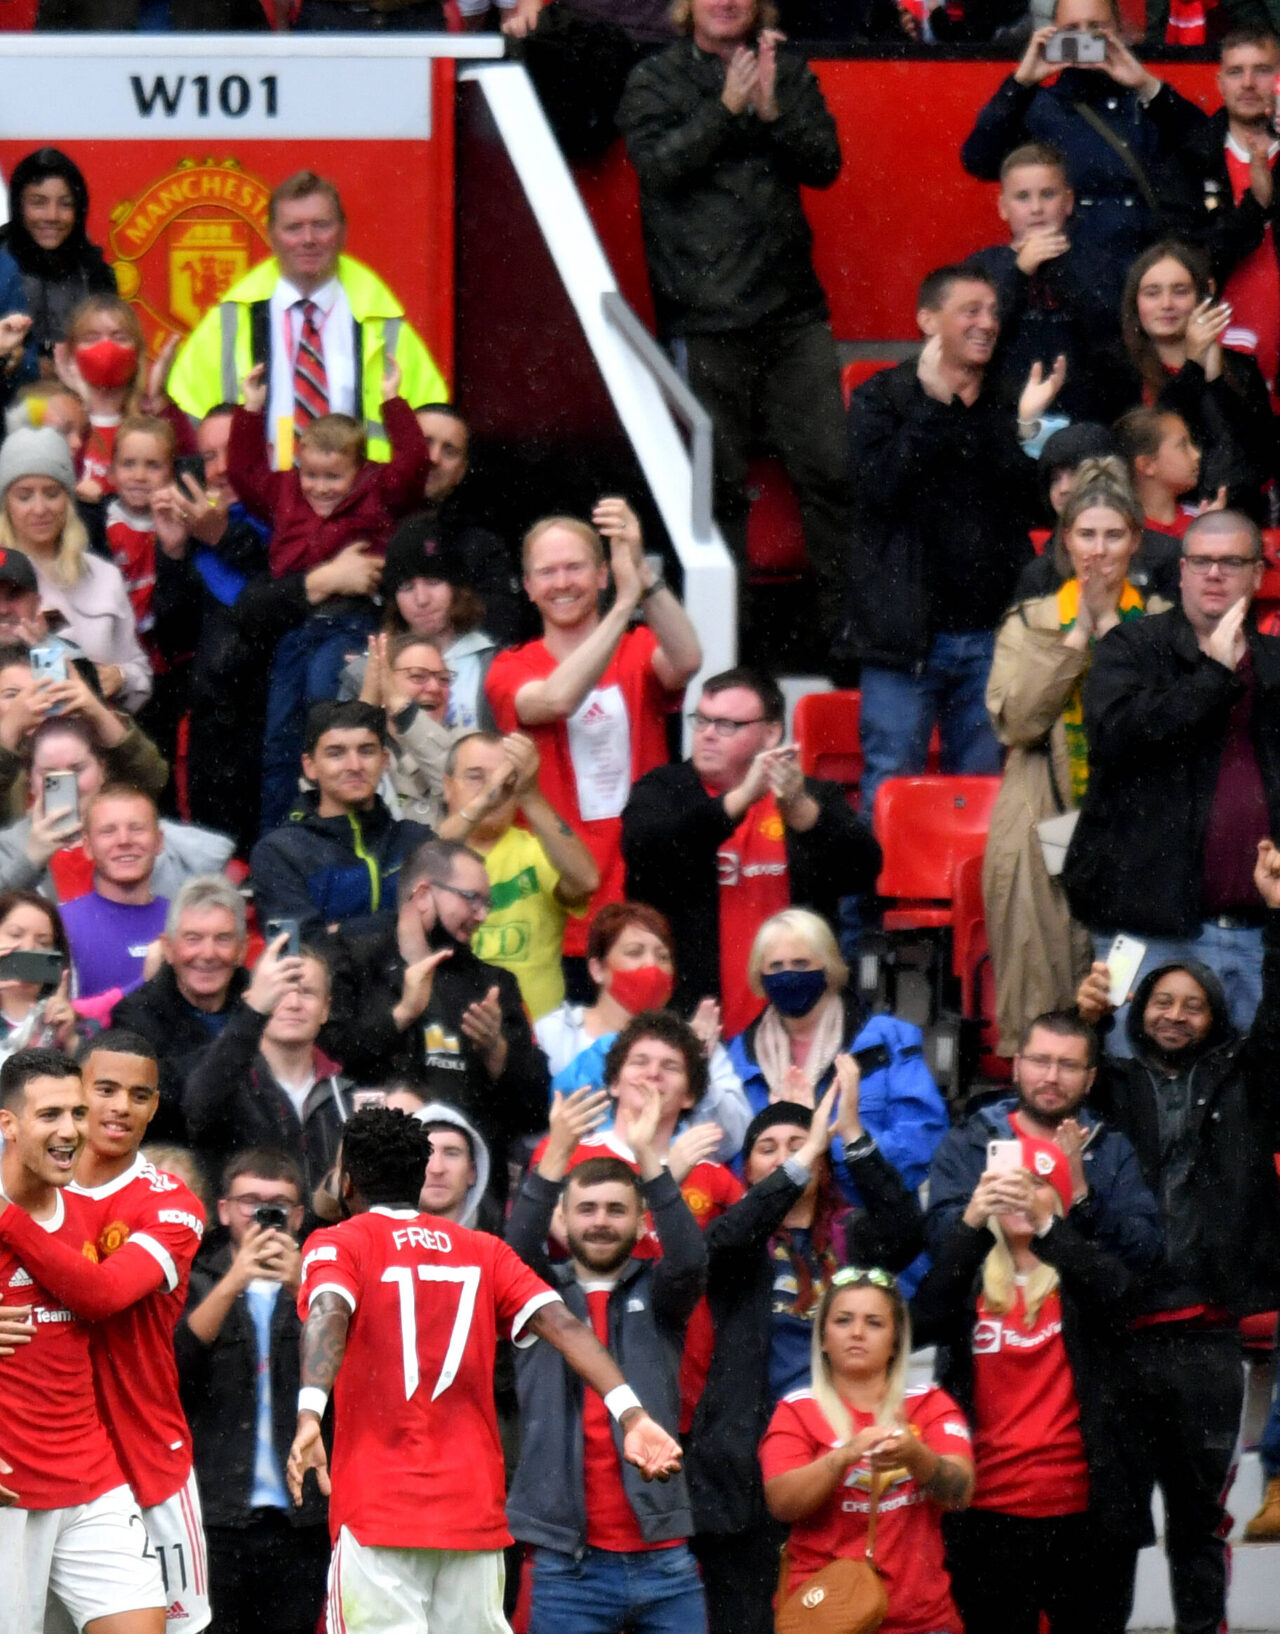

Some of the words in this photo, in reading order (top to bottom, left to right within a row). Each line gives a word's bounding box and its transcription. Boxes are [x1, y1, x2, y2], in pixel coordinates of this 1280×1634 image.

[129, 75, 278, 118] W101
[392, 1227, 452, 1253] FRED
[381, 1265, 481, 1402] 17
[155, 1543, 187, 1593] 11
